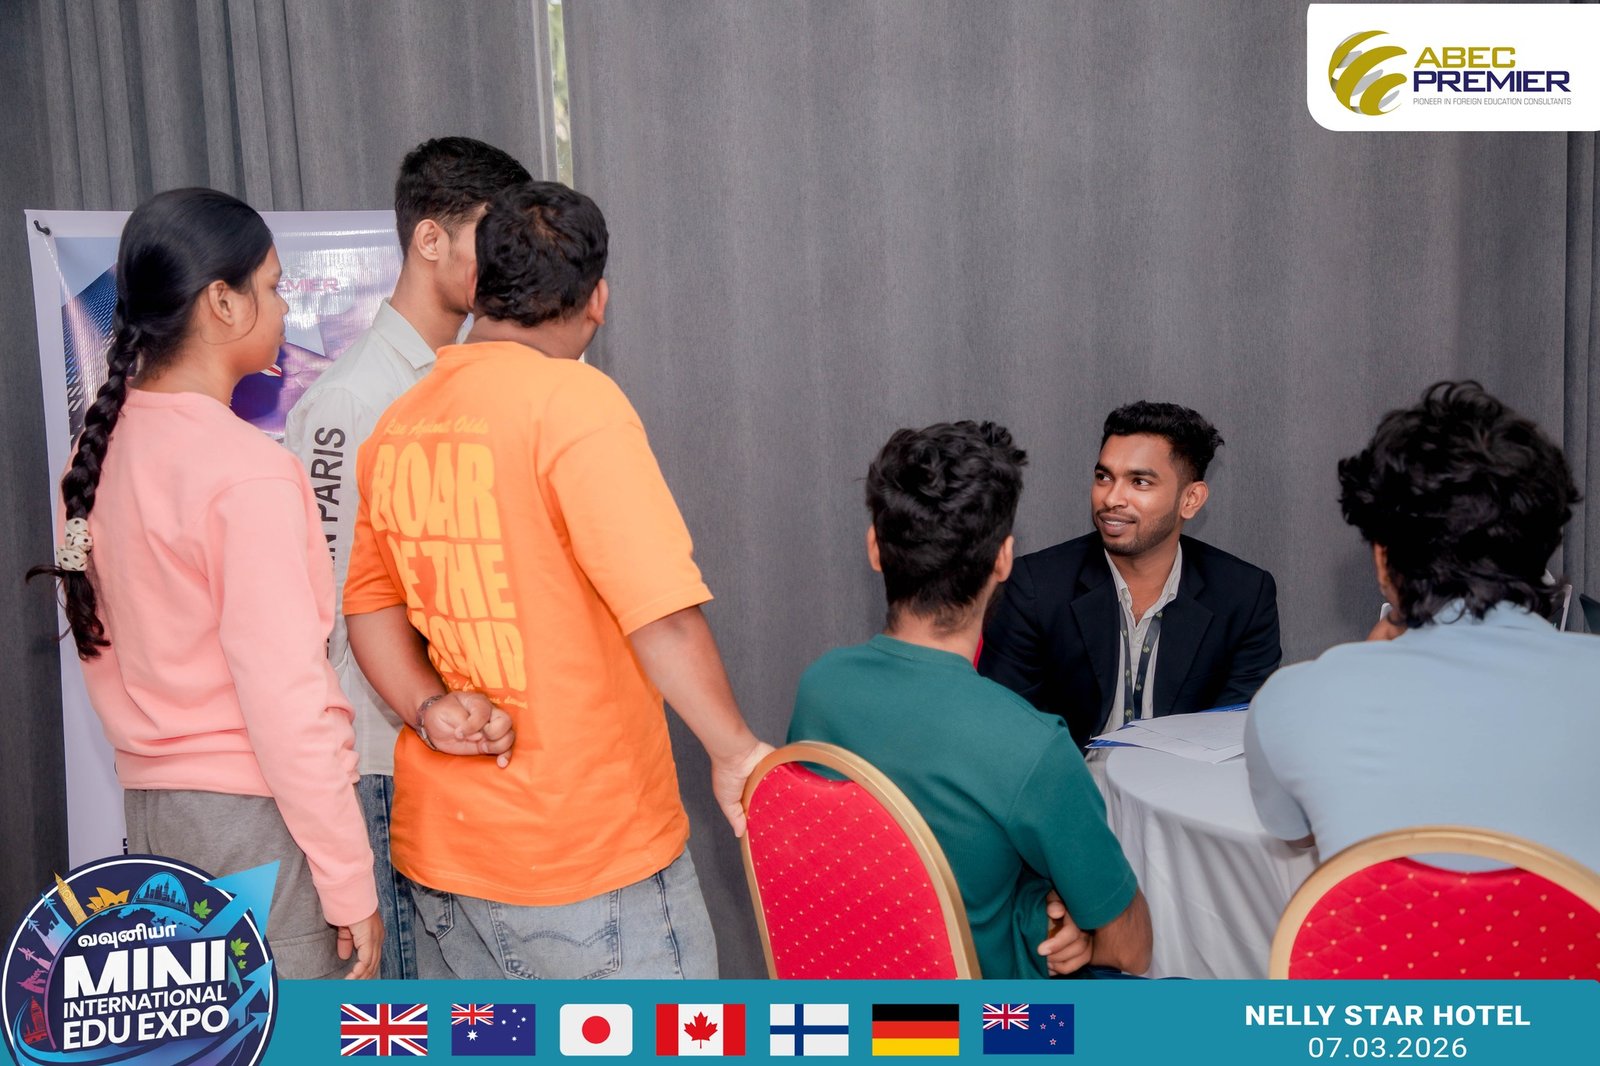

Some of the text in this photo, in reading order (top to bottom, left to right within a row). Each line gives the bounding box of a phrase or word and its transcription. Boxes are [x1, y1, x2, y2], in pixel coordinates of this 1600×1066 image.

[275, 276, 340, 294] EMIER
[370, 441, 502, 540] ROAR
[418, 540, 517, 620] THE
